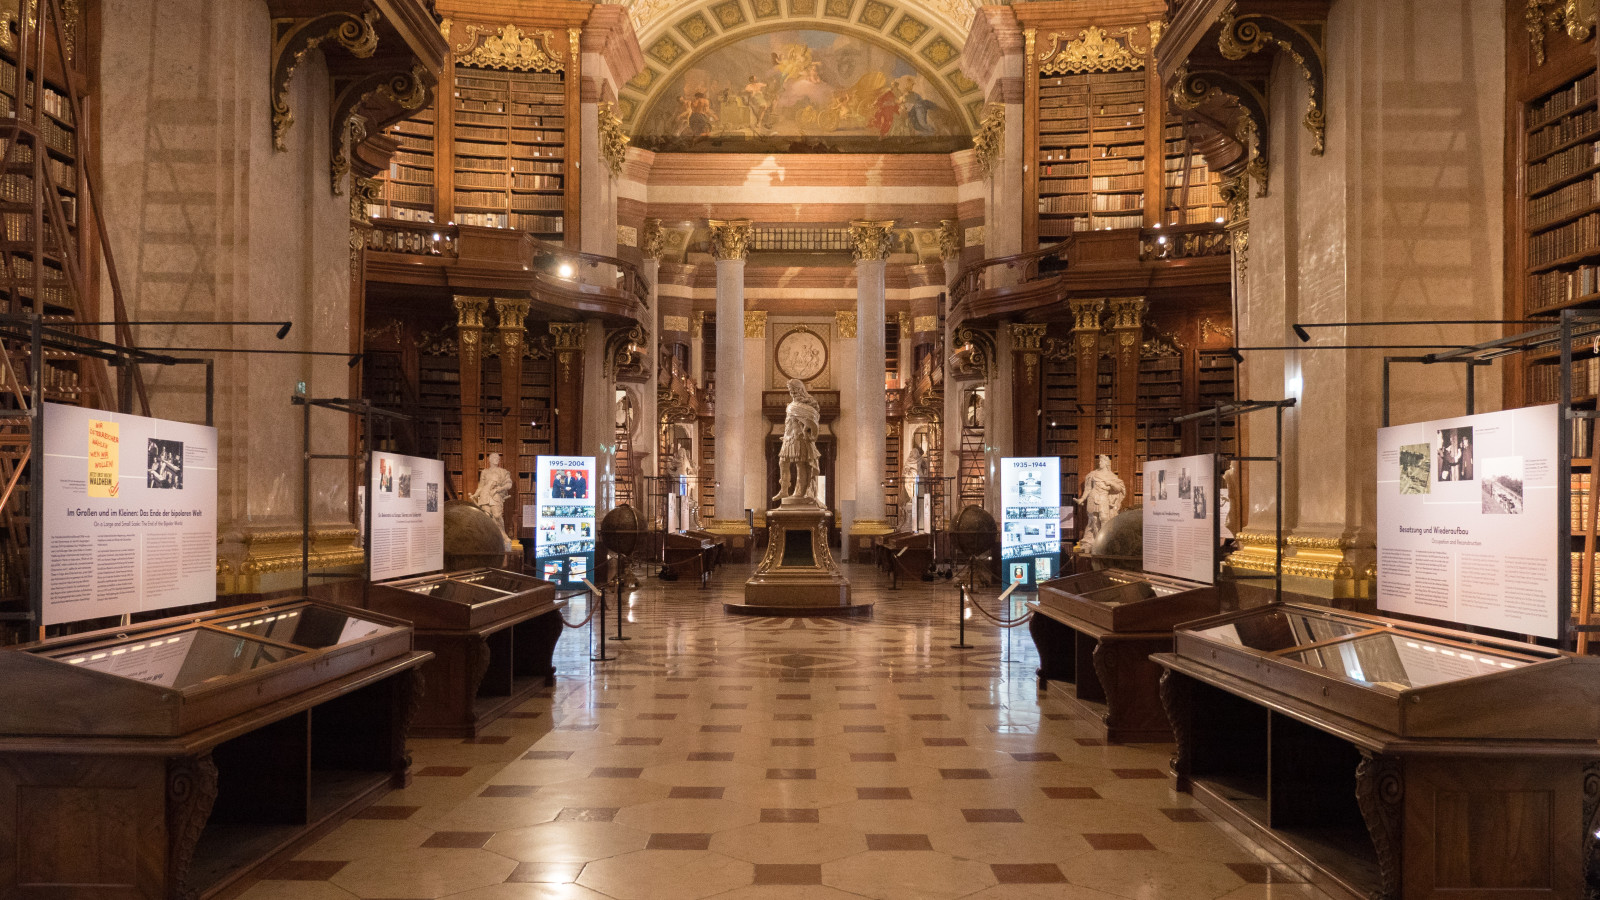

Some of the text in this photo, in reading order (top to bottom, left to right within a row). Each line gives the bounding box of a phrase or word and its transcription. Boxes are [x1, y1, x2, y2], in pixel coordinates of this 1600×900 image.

[67, 508, 75, 516] Im
[76, 508, 97, 517] Großen
[99, 509, 109, 517] und
[111, 509, 117, 517] im
[119, 509, 138, 517] Kleinen:
[140, 509, 149, 517] Das
[150, 509, 161, 517] Ende
[171, 509, 191, 518] bipolaren
[192, 509, 202, 517] Welt
[1399, 526, 1469, 535] Besatzung und Wiederaufbau
